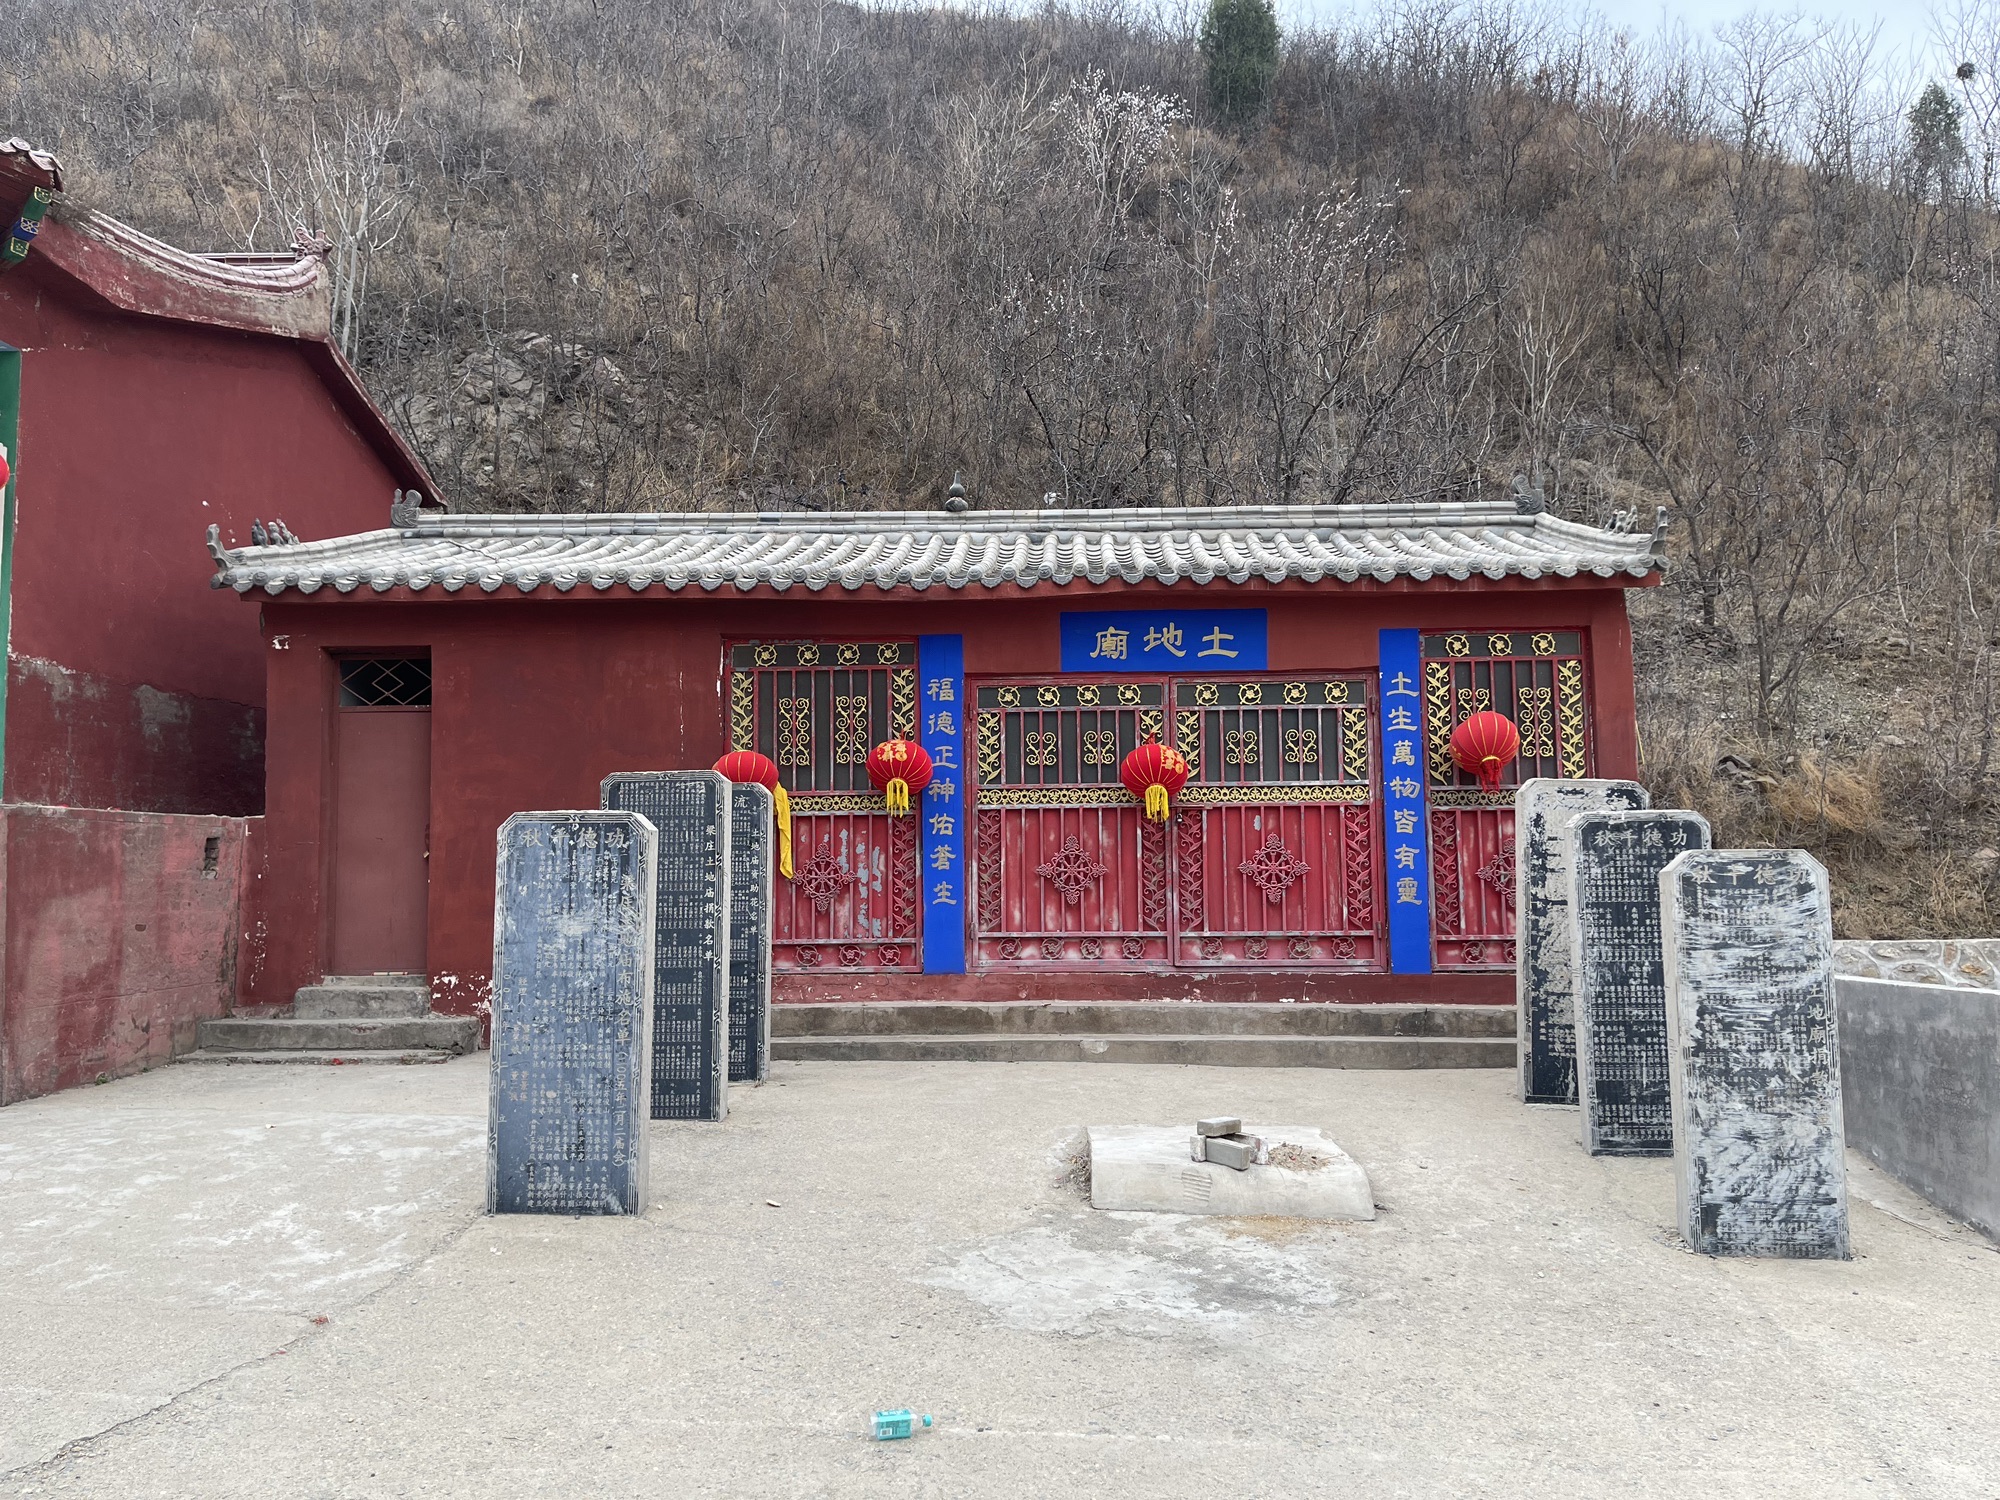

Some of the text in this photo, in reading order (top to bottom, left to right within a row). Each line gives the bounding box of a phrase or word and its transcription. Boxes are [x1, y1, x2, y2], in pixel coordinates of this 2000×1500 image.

[927, 677, 958, 905] 福德正神佑蒼生
[1386, 671, 1422, 906] 土生萬物皆有靈
